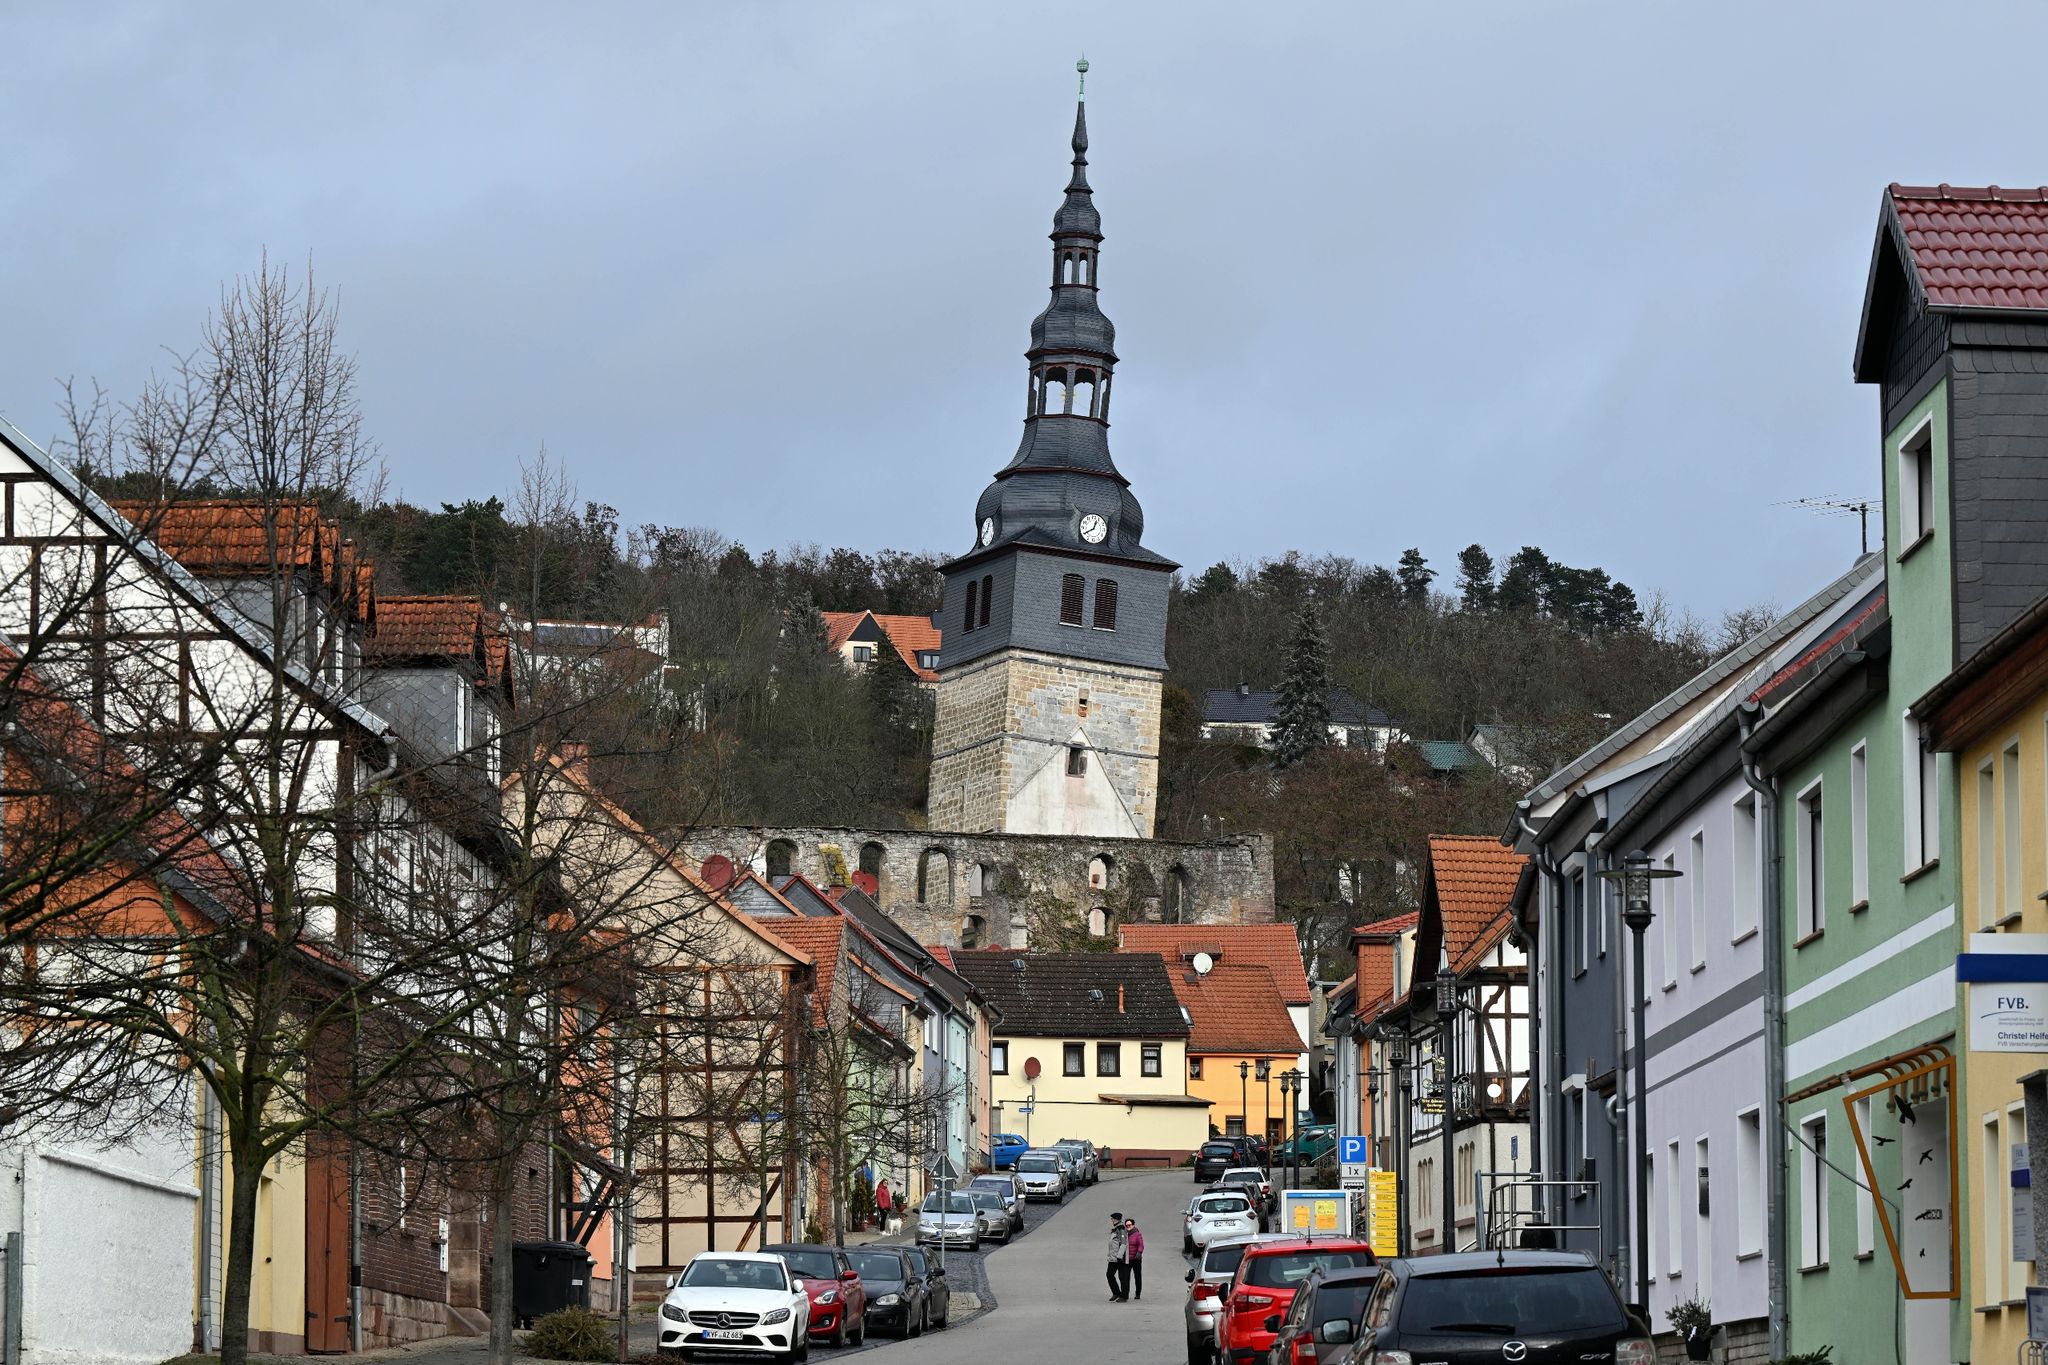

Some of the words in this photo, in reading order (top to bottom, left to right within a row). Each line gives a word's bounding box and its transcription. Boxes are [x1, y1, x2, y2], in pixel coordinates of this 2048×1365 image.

[1998, 997, 2029, 1009] FVB.
[1997, 1032, 2027, 1040] Christel
[1346, 1139, 1360, 1160] P
